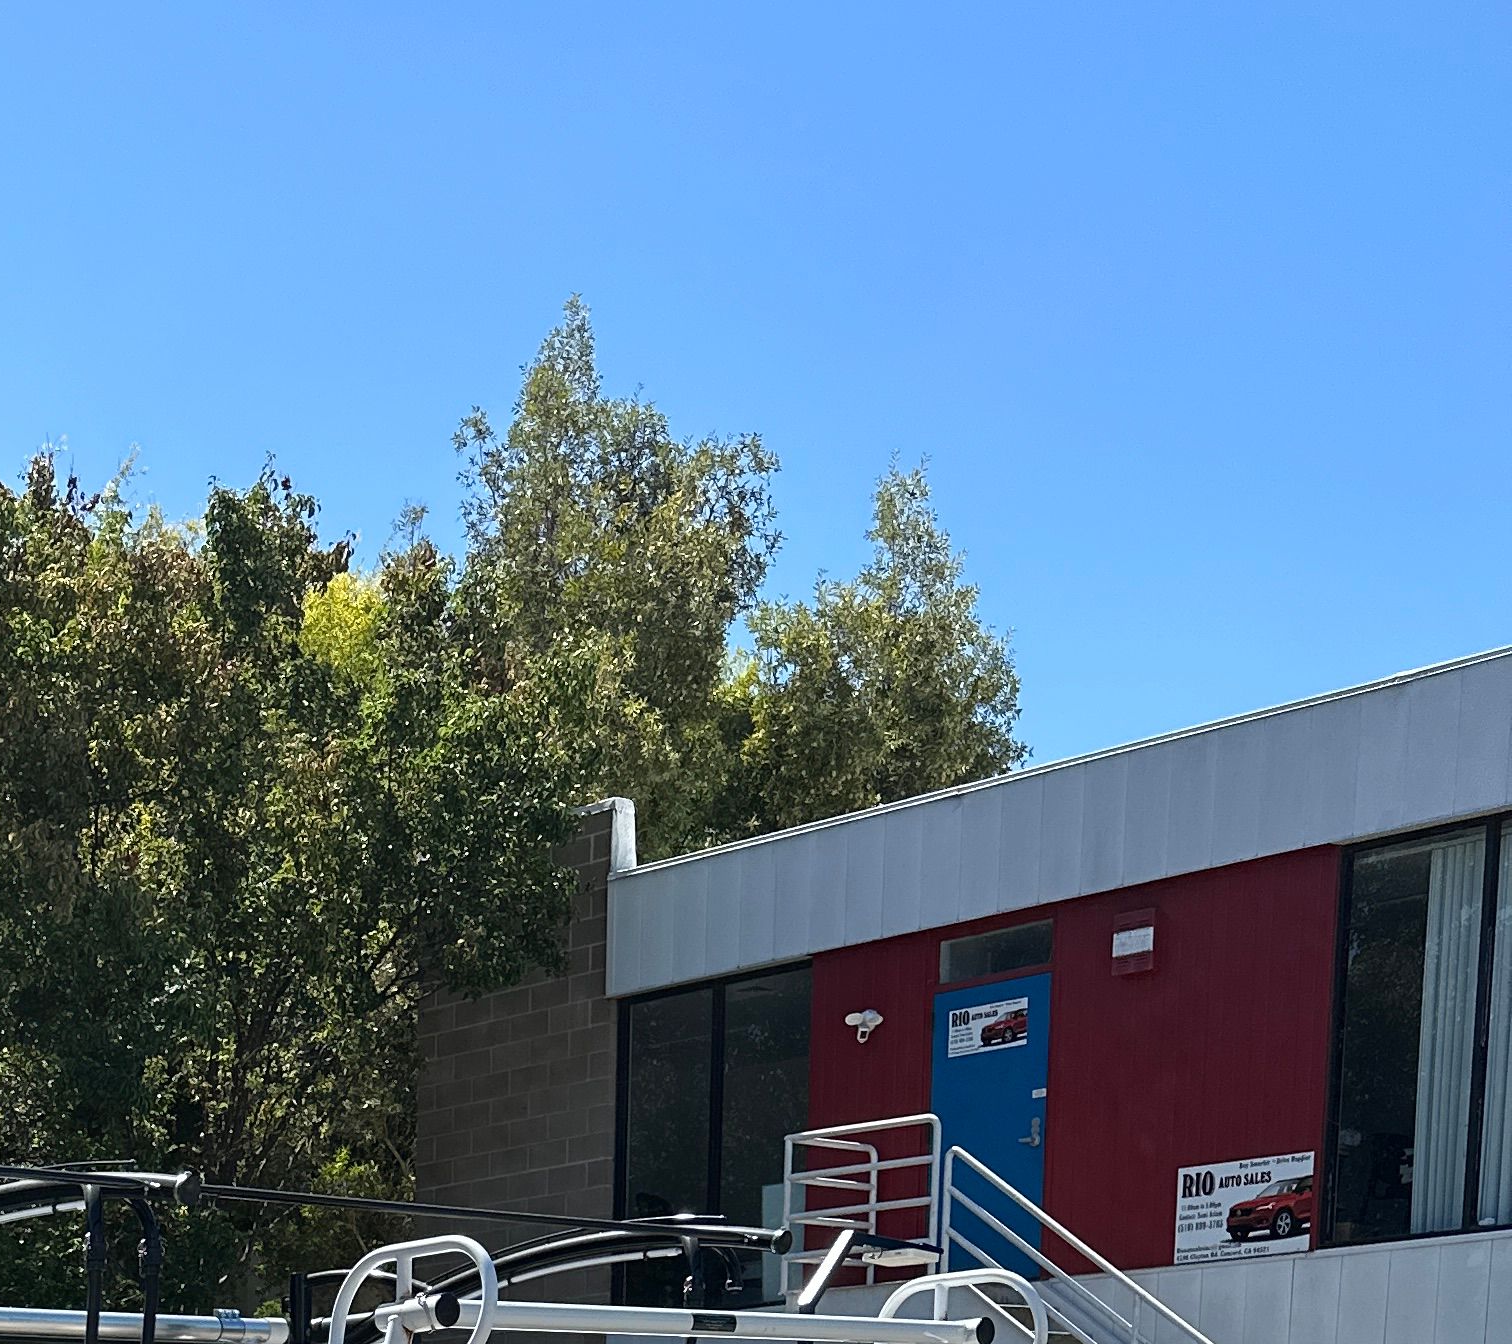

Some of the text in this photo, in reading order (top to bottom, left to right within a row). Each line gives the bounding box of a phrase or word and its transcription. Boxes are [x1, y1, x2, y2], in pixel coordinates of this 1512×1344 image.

[952, 1010, 970, 1028] RIO
[1182, 1170, 1271, 1198] RIO AUTO SALES
